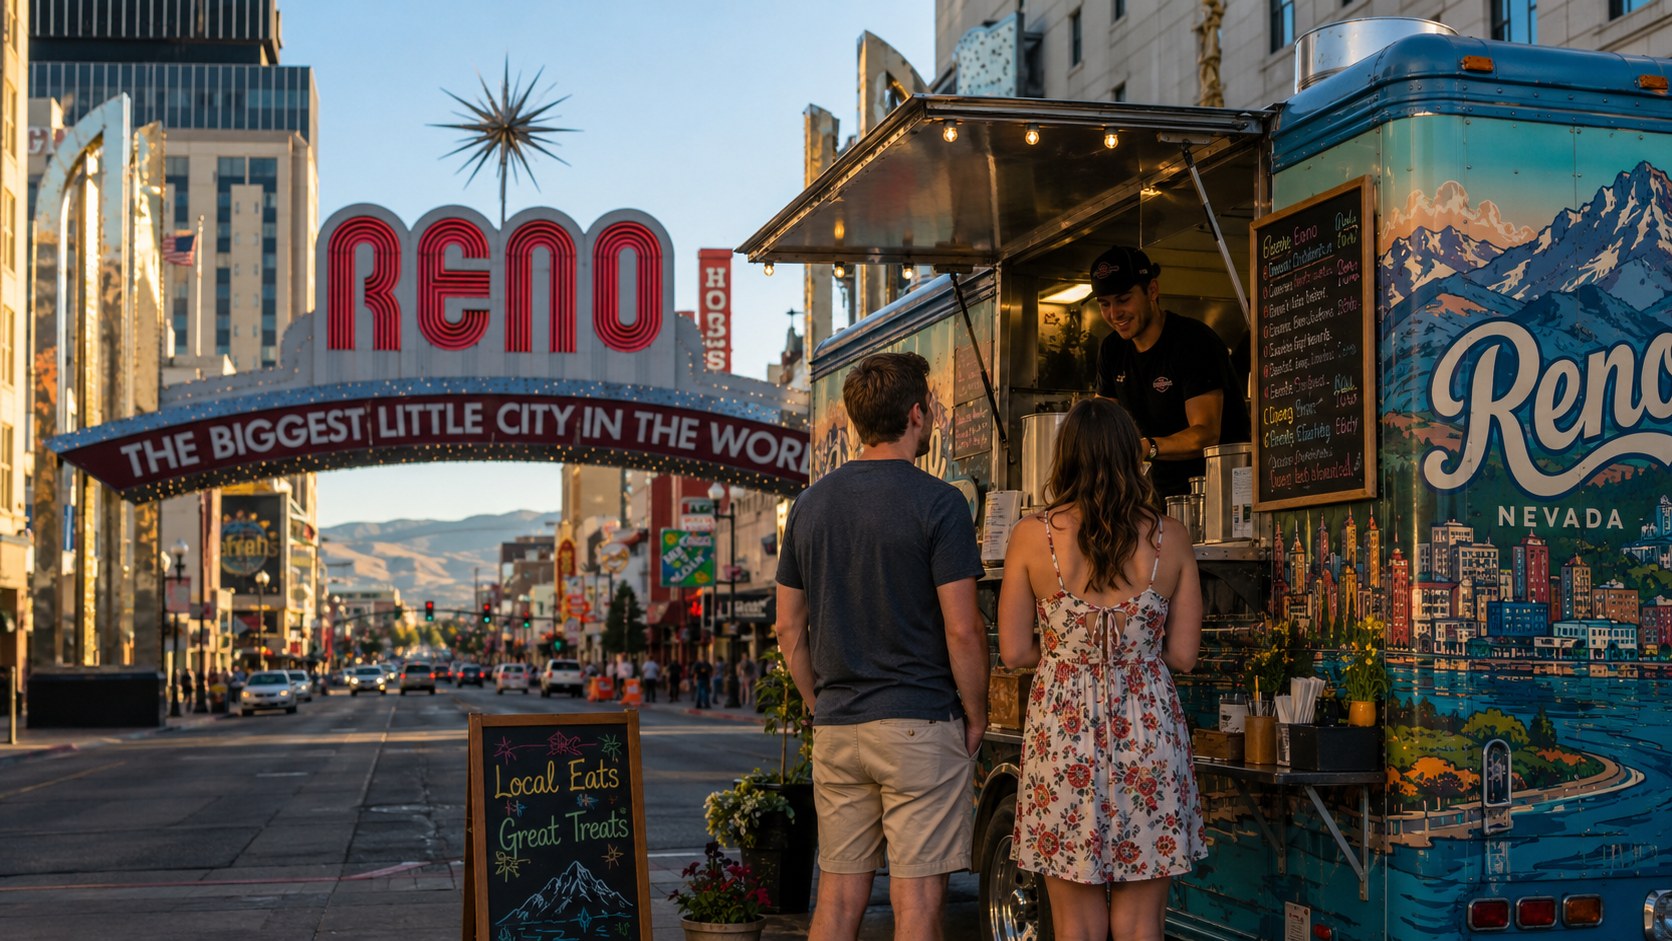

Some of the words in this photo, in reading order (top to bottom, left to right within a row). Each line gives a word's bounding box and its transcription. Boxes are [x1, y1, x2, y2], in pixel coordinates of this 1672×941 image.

[328, 216, 662, 353] RENO
[120, 431, 199, 478] THE
[209, 407, 365, 460] BIGGEST
[378, 402, 483, 438] LITTLE
[496, 402, 575, 436] CITY
[582, 406, 623, 440] IN
[634, 410, 699, 450] THE
[1498, 505, 1624, 529] NEVADA
[494, 760, 559, 799] Local
[568, 758, 619, 791] Eats
[500, 815, 561, 860] Great
[565, 810, 629, 842] Treats
